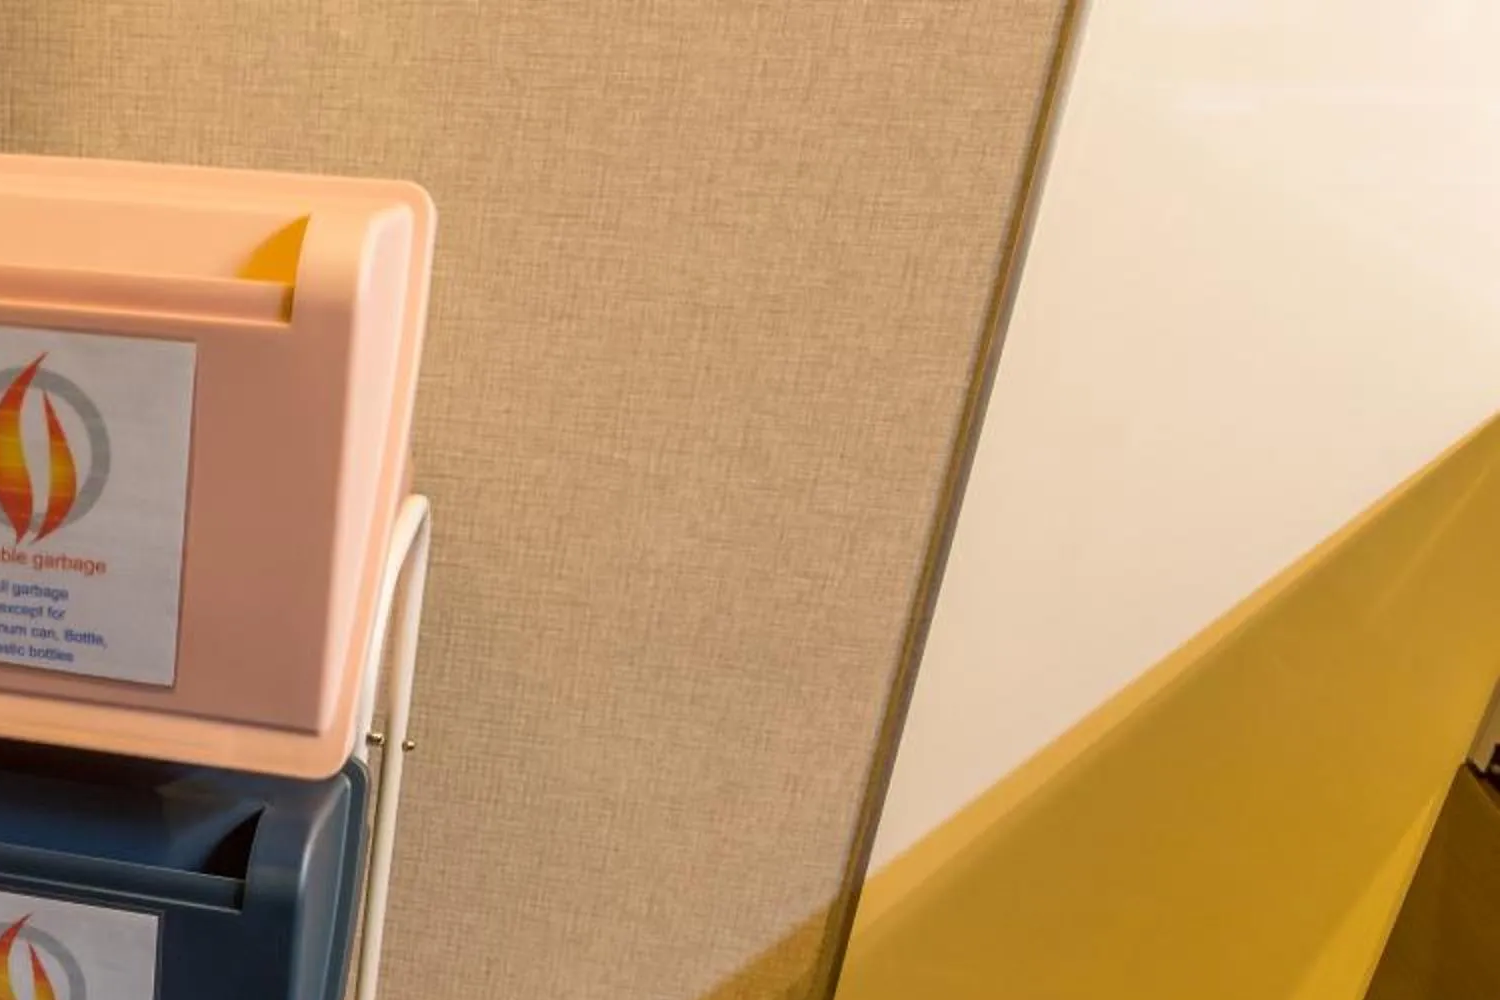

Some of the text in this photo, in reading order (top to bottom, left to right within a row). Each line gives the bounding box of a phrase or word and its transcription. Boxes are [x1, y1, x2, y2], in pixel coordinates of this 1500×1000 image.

[32, 552, 107, 576] garbage
[12, 583, 69, 601] garbage
[48, 606, 66, 620] for
[29, 645, 74, 662] bottles
